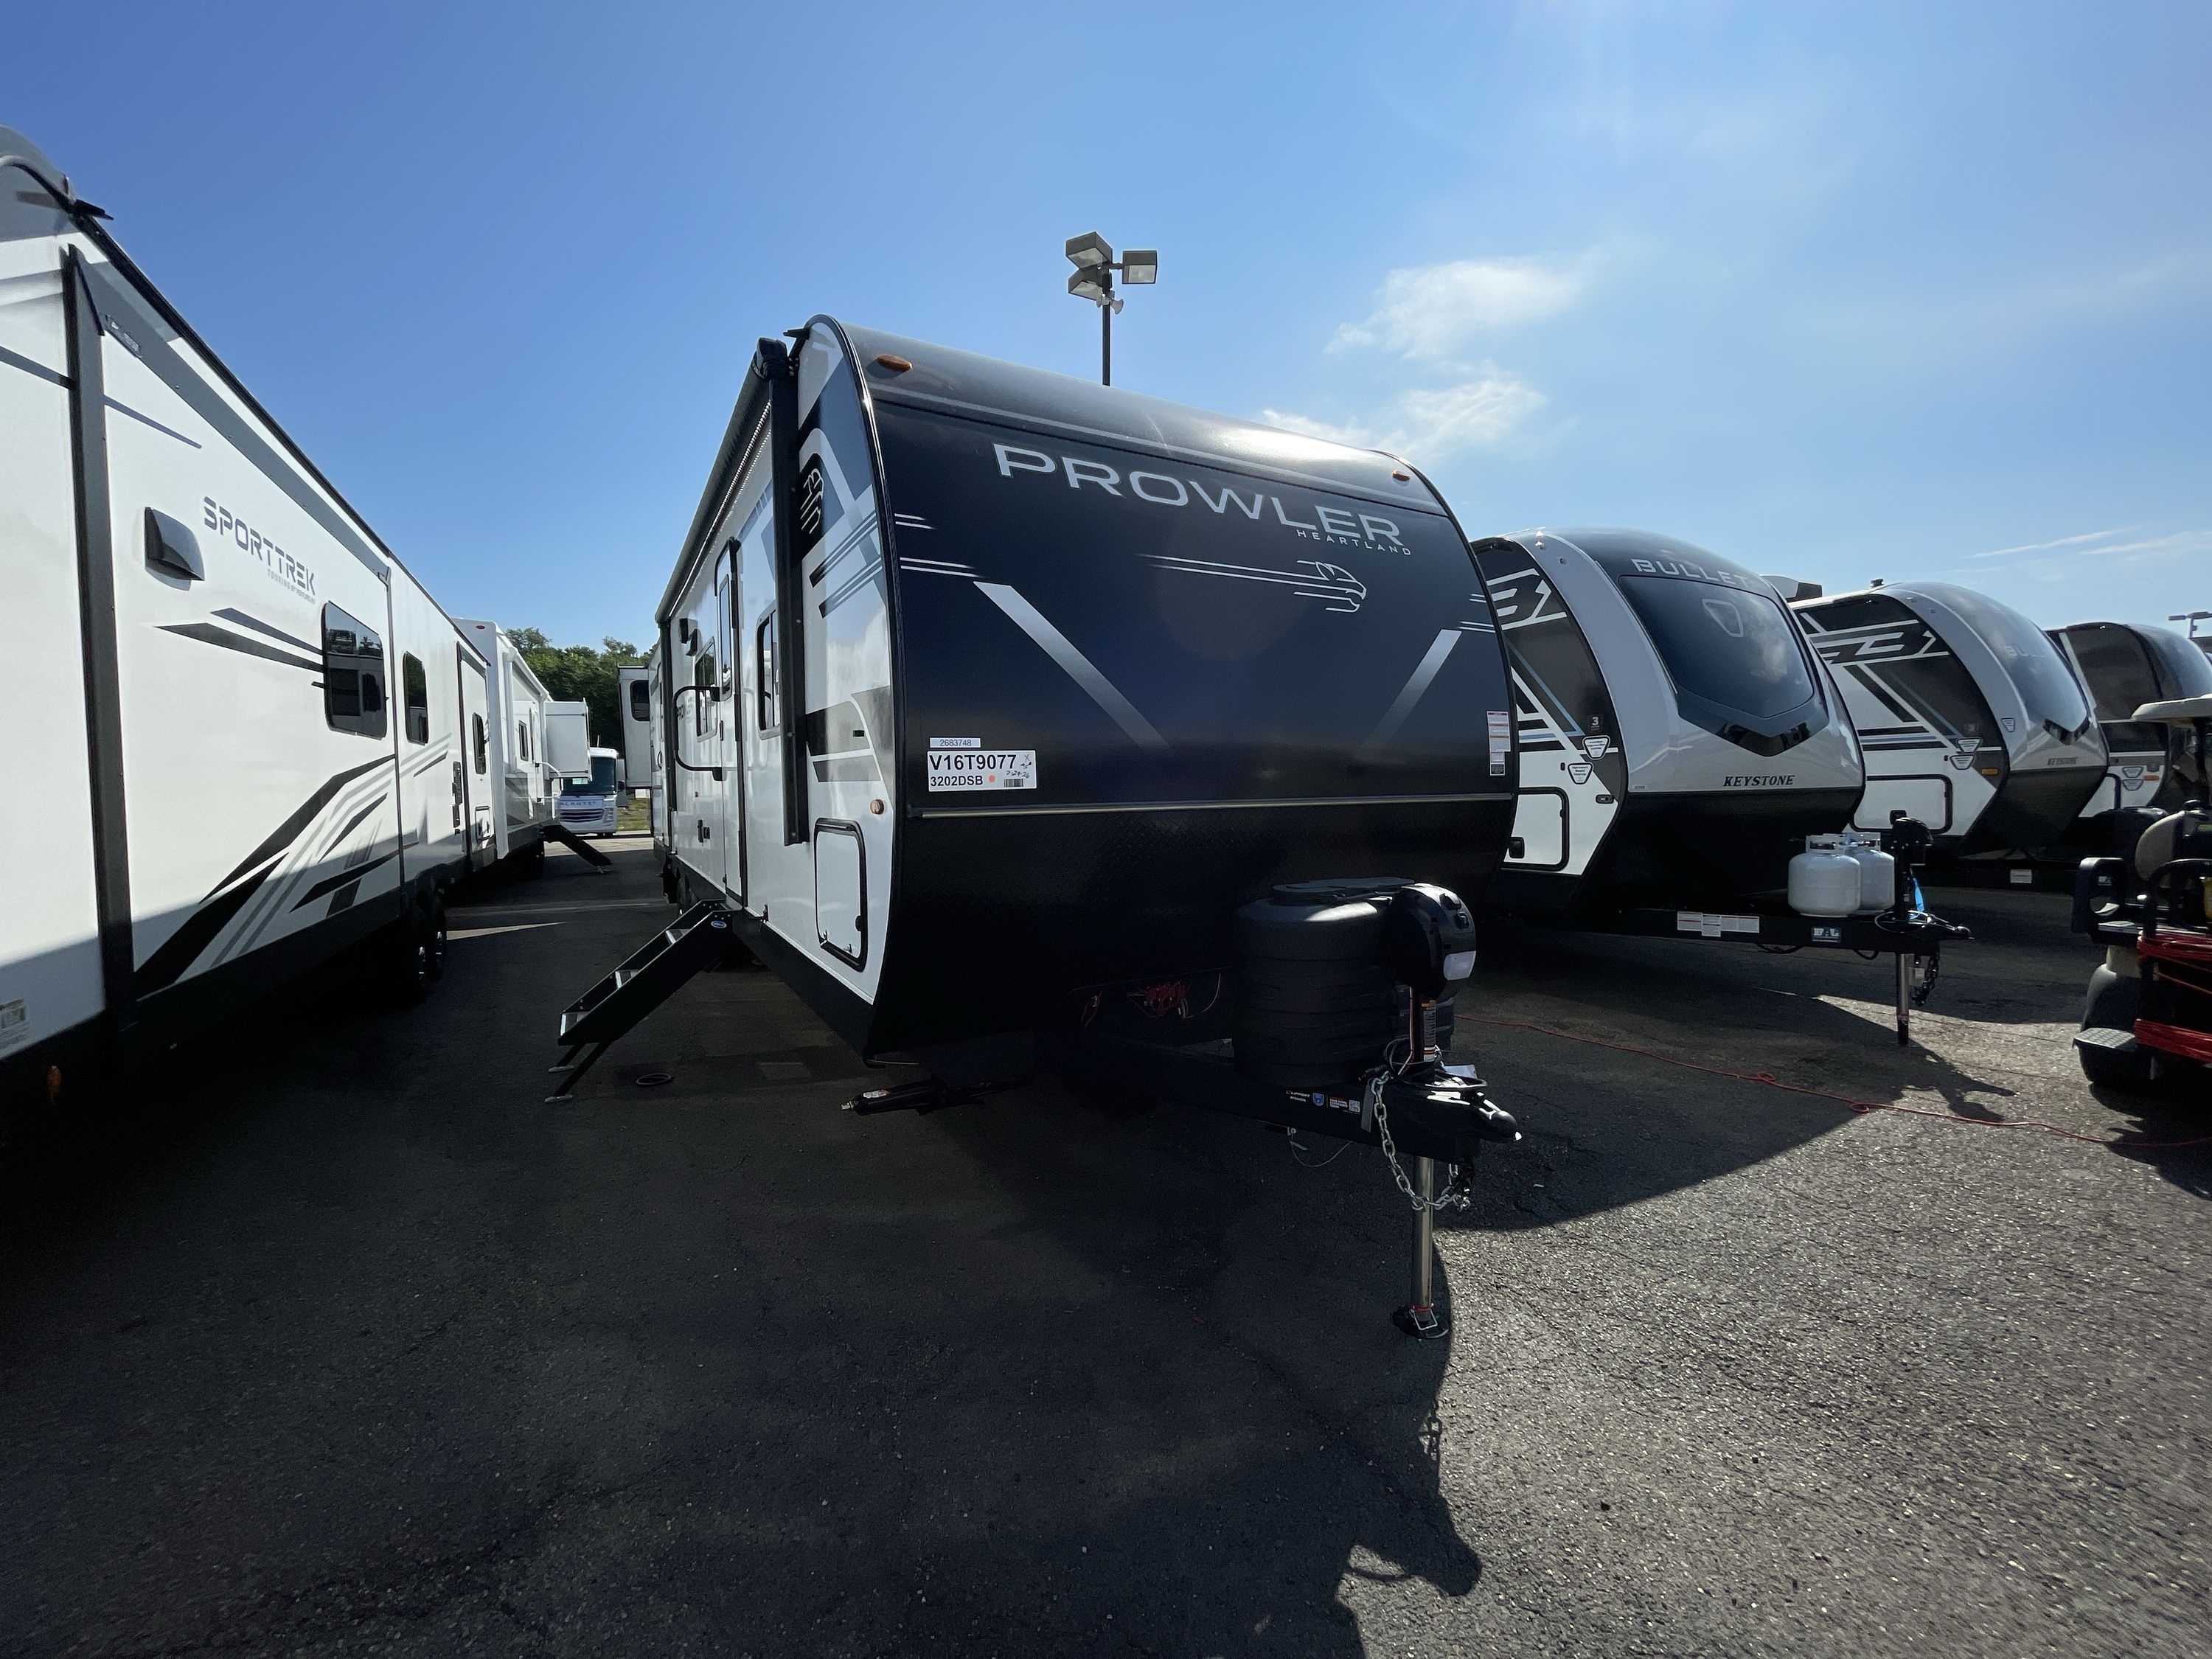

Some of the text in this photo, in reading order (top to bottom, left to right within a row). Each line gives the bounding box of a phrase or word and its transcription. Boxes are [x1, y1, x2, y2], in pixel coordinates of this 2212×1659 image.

[992, 443, 1404, 546] PROWLER
[204, 496, 316, 595] SPORTTREK
[1295, 529, 1411, 555] HEARTLAND
[1630, 558, 1748, 588] BULLET
[939, 739, 972, 747] 2683748
[929, 754, 1017, 771] V16T9077
[931, 776, 984, 786] 3202DSB
[1723, 775, 1795, 787] KEYSTONE
